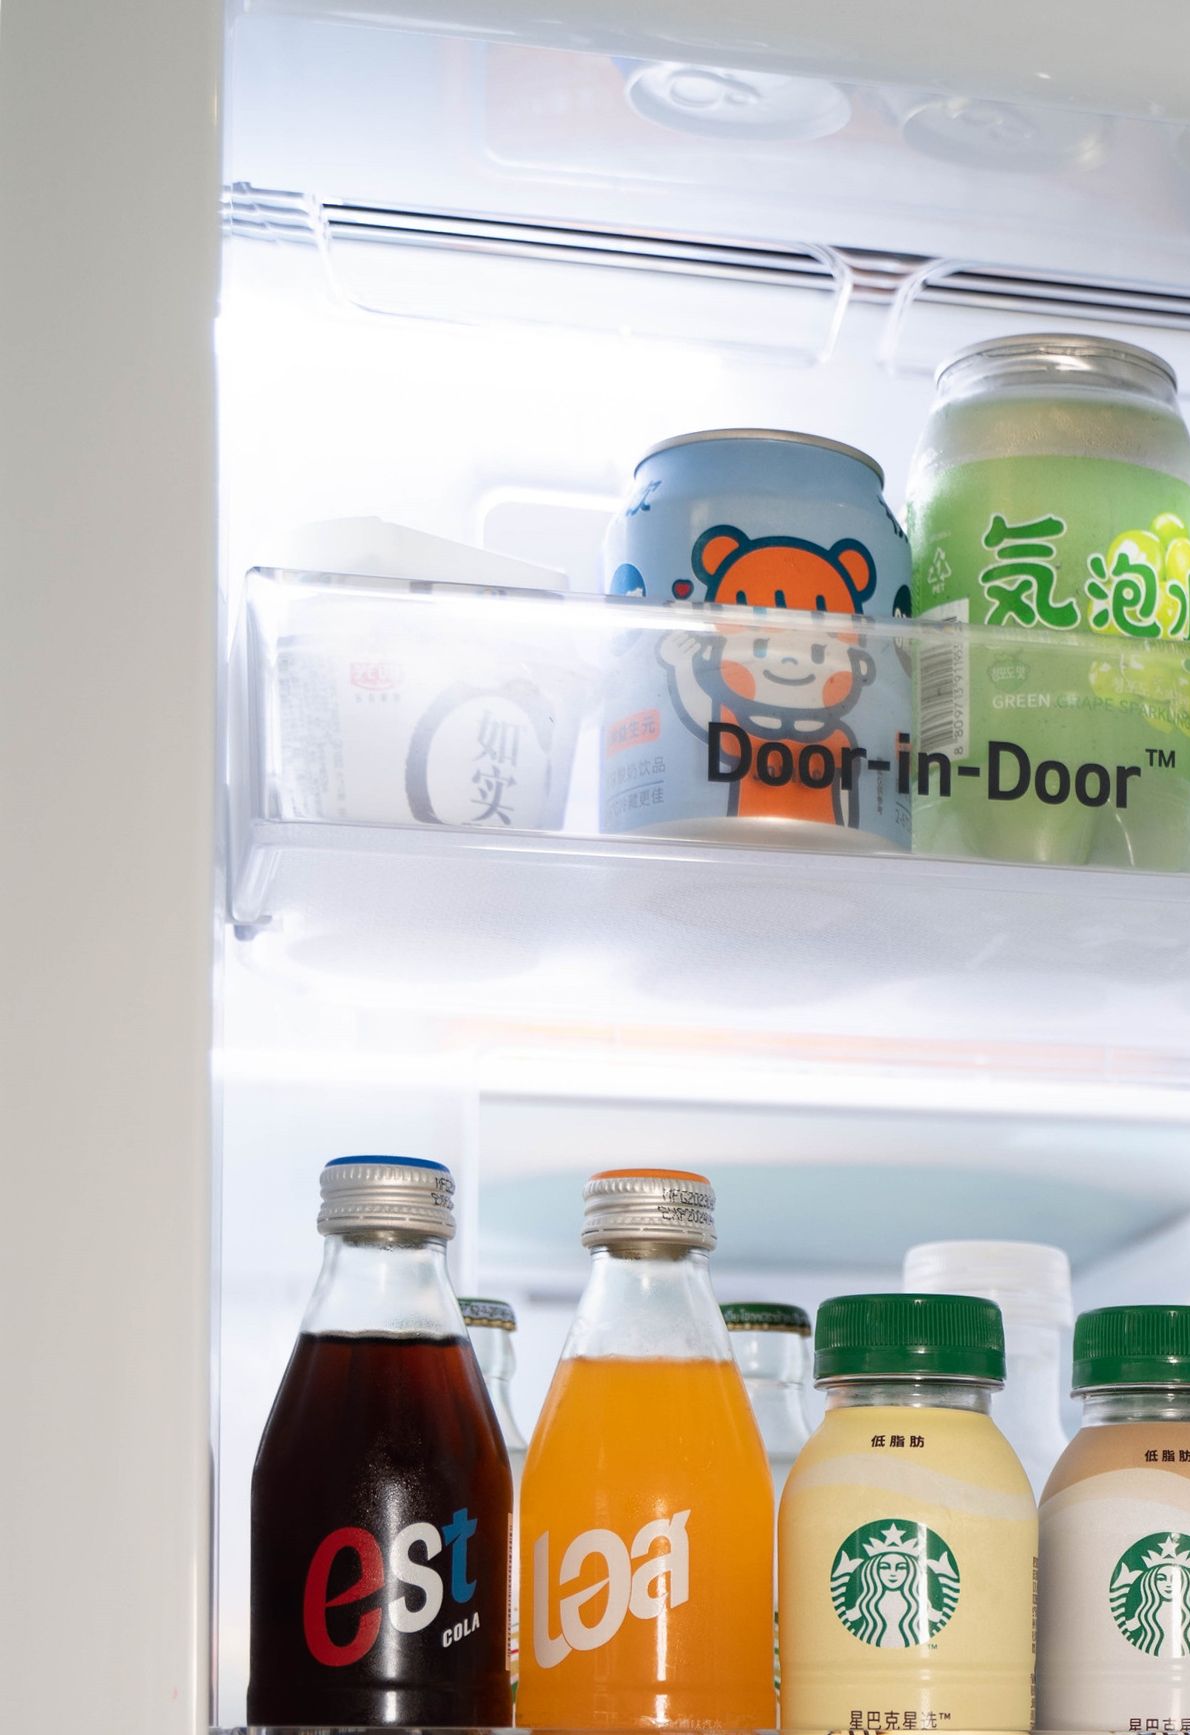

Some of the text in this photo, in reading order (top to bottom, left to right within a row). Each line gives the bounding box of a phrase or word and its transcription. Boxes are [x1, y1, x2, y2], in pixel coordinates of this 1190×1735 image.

[992, 694, 1050, 710] GREEN
[870, 1433, 925, 1450] 低脂肪
[303, 1507, 478, 1667] est
[442, 1612, 481, 1649] COLA
